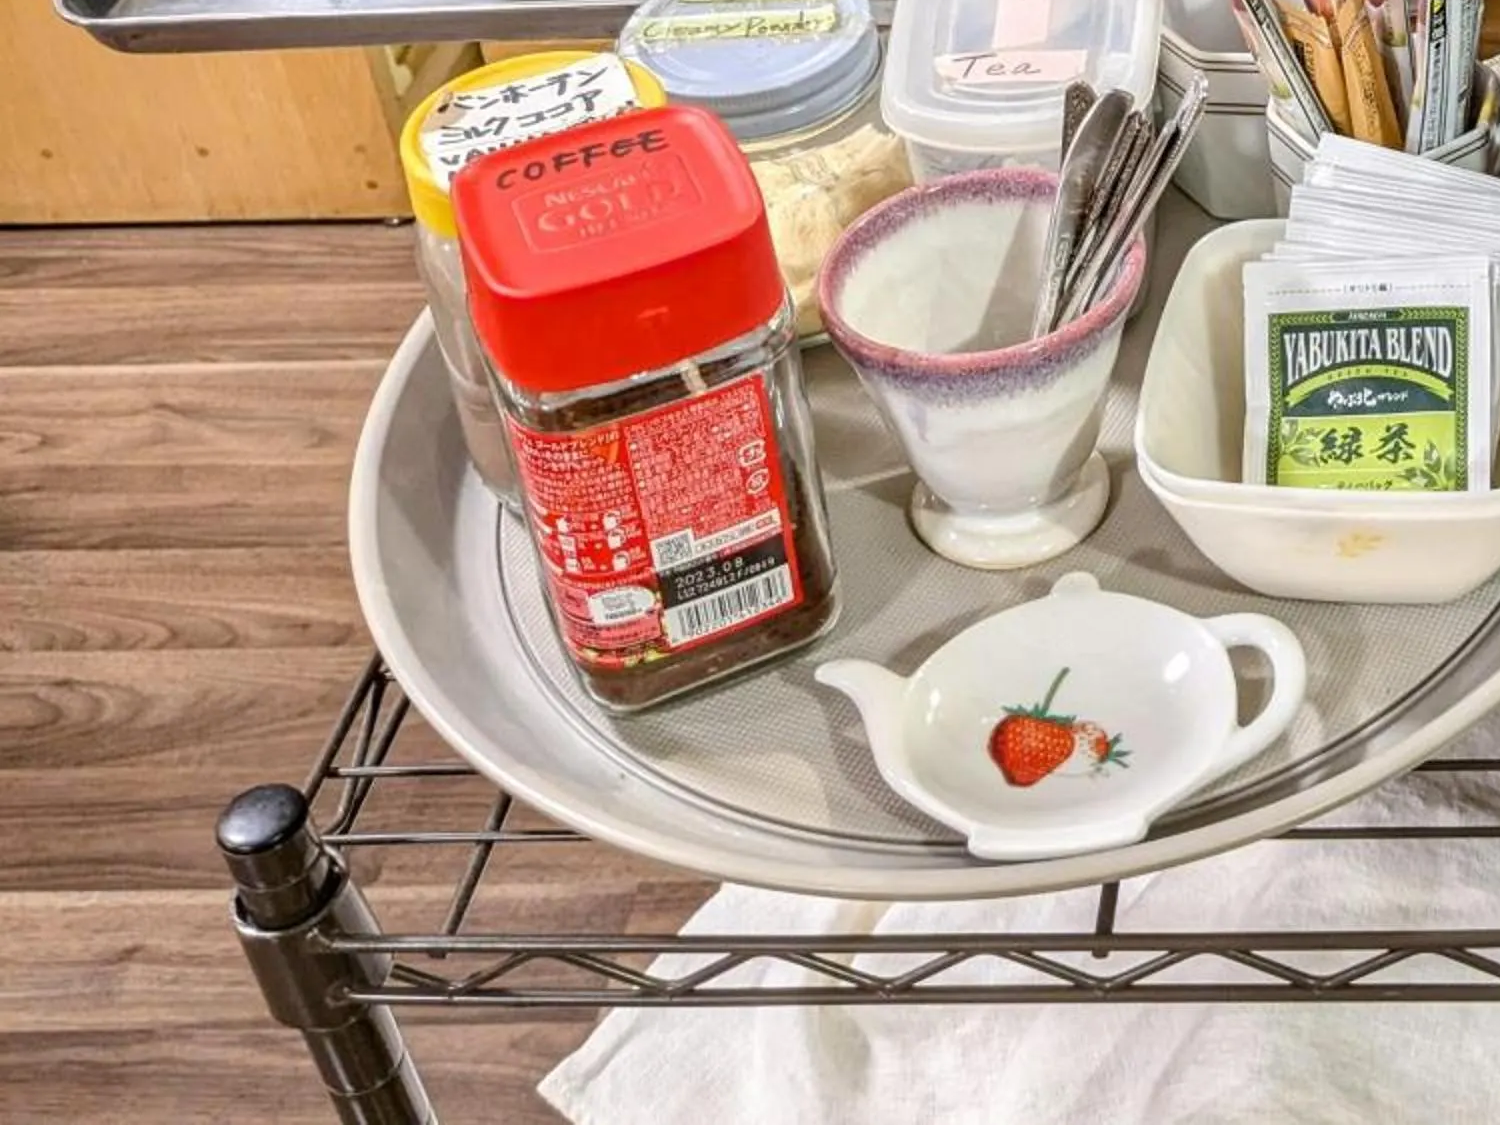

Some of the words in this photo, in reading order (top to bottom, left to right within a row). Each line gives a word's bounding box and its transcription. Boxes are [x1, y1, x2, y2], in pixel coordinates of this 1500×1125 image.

[954, 55, 1041, 78] Tea
[439, 89, 603, 145] ミルクココア
[496, 129, 671, 191] COFFEE
[1283, 328, 1382, 386] YABUKITA
[1386, 326, 1453, 378] BLEND
[1319, 422, 1416, 465] 緑茶
